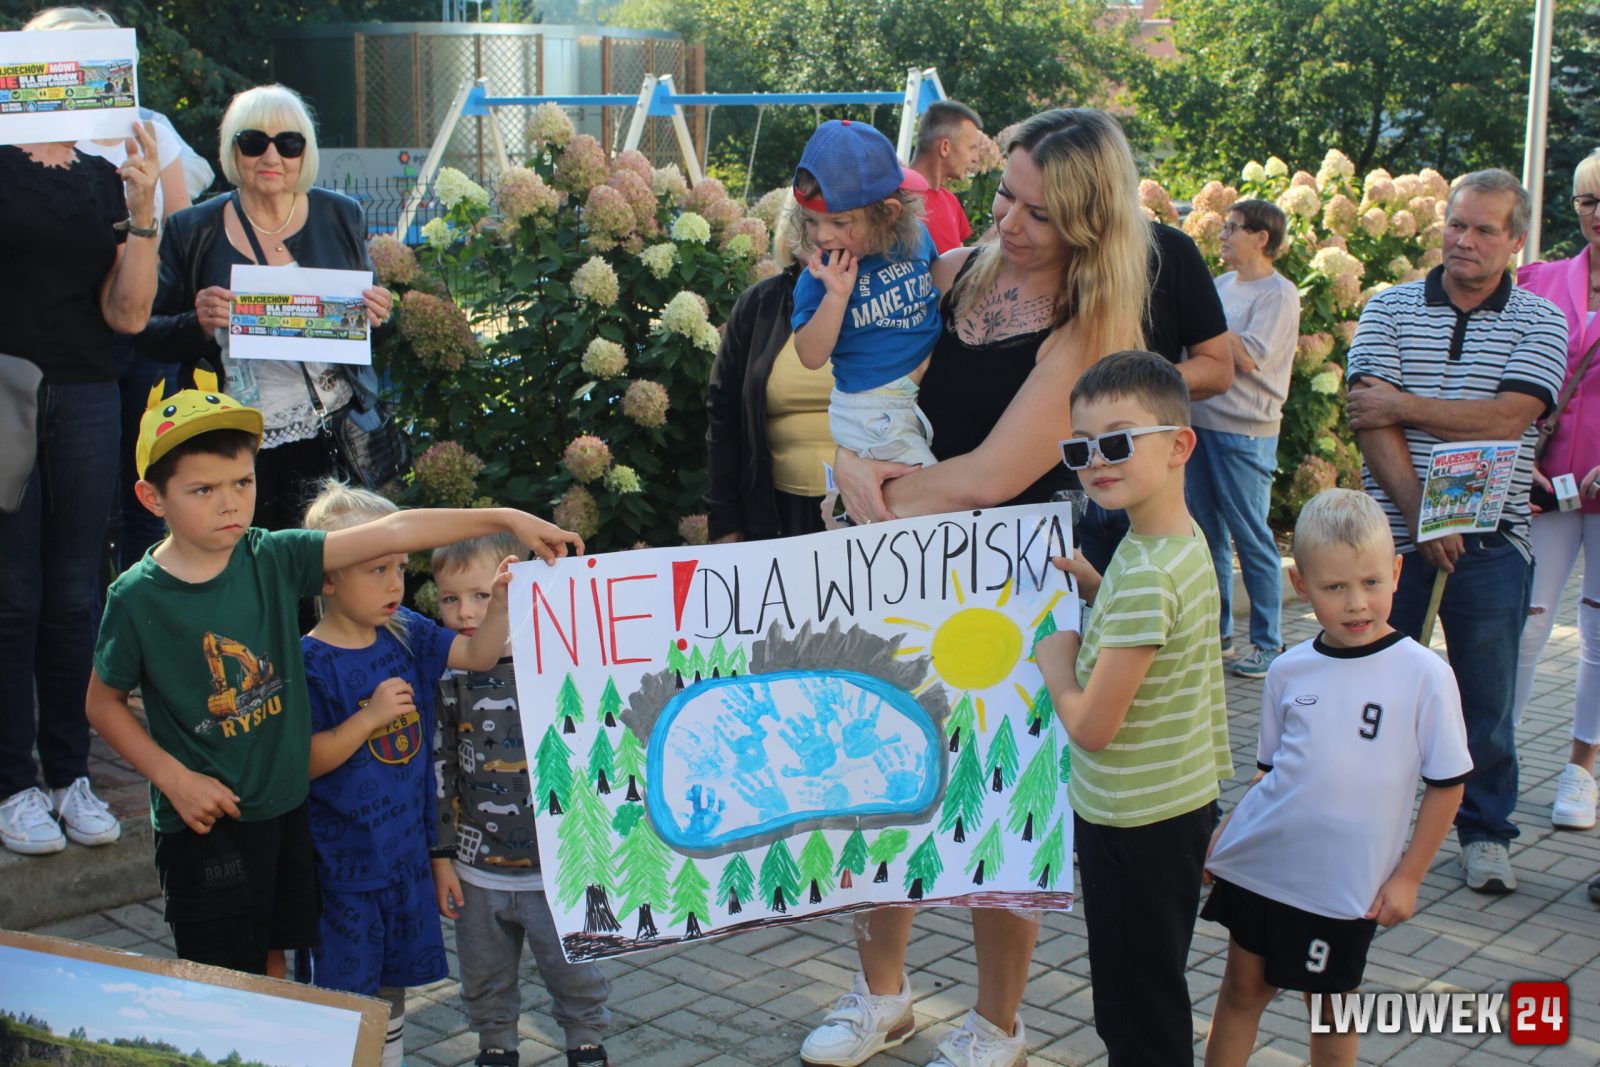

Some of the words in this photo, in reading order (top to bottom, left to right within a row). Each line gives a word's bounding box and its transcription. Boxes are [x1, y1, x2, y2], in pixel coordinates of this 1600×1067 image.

[19, 75, 36, 83] DLA
[234, 303, 265, 315] NIE
[852, 286, 904, 329] MAKE
[876, 317, 910, 329] NEVER
[695, 557, 795, 640] DLA
[221, 695, 282, 738] RYSIU
[386, 717, 407, 732] FCB
[1359, 702, 1382, 740] 9
[350, 795, 390, 820] ORÇA
[205, 859, 243, 881] BRAVE
[1306, 938, 1331, 974] 9
